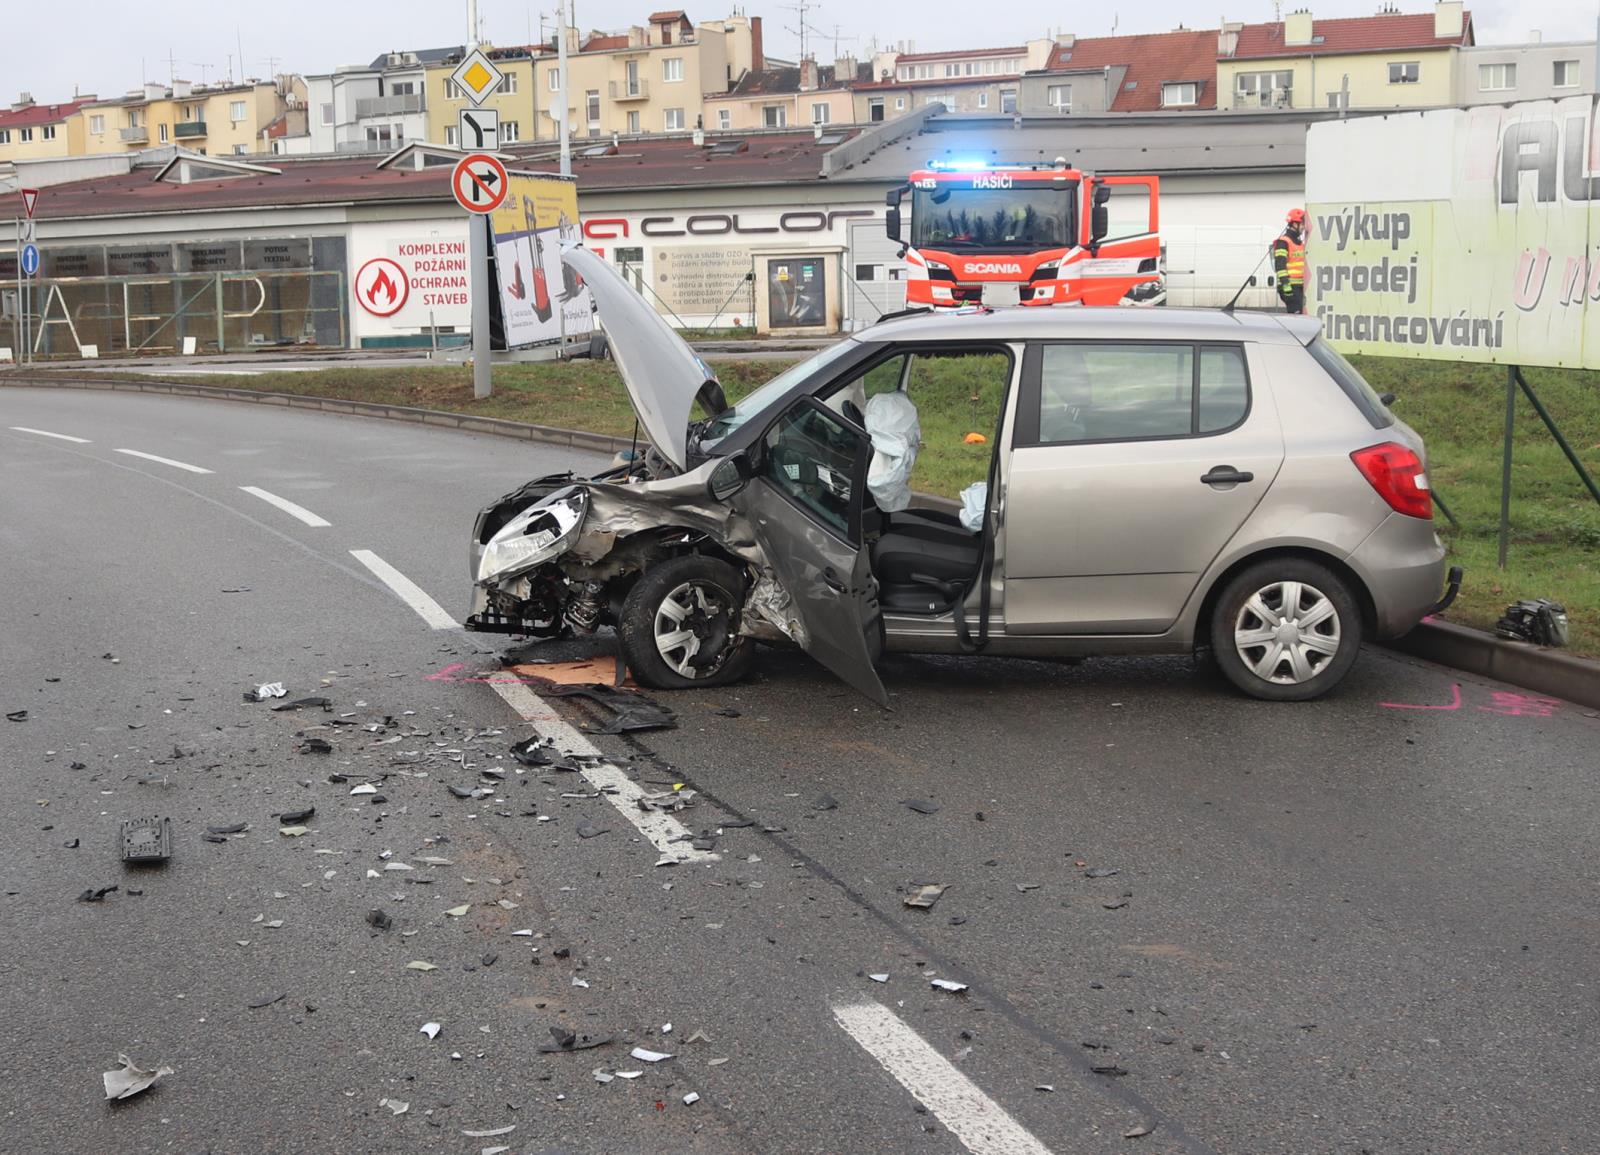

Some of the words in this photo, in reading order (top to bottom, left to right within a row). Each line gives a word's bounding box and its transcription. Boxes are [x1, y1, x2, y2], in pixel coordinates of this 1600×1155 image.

[973, 174, 1013, 189] HASIČI
[1318, 205, 1411, 250] výkup
[398, 240, 466, 256] KOMPLEXNÍ
[414, 257, 466, 272] POŽÁRNÍ
[963, 262, 1022, 274] SCANIA
[410, 277, 467, 289] OCHRANA
[1316, 256, 1418, 303] prodej
[1062, 283, 1070, 294] 1
[423, 293, 468, 306] STAVEB
[1316, 304, 1505, 348] financování
